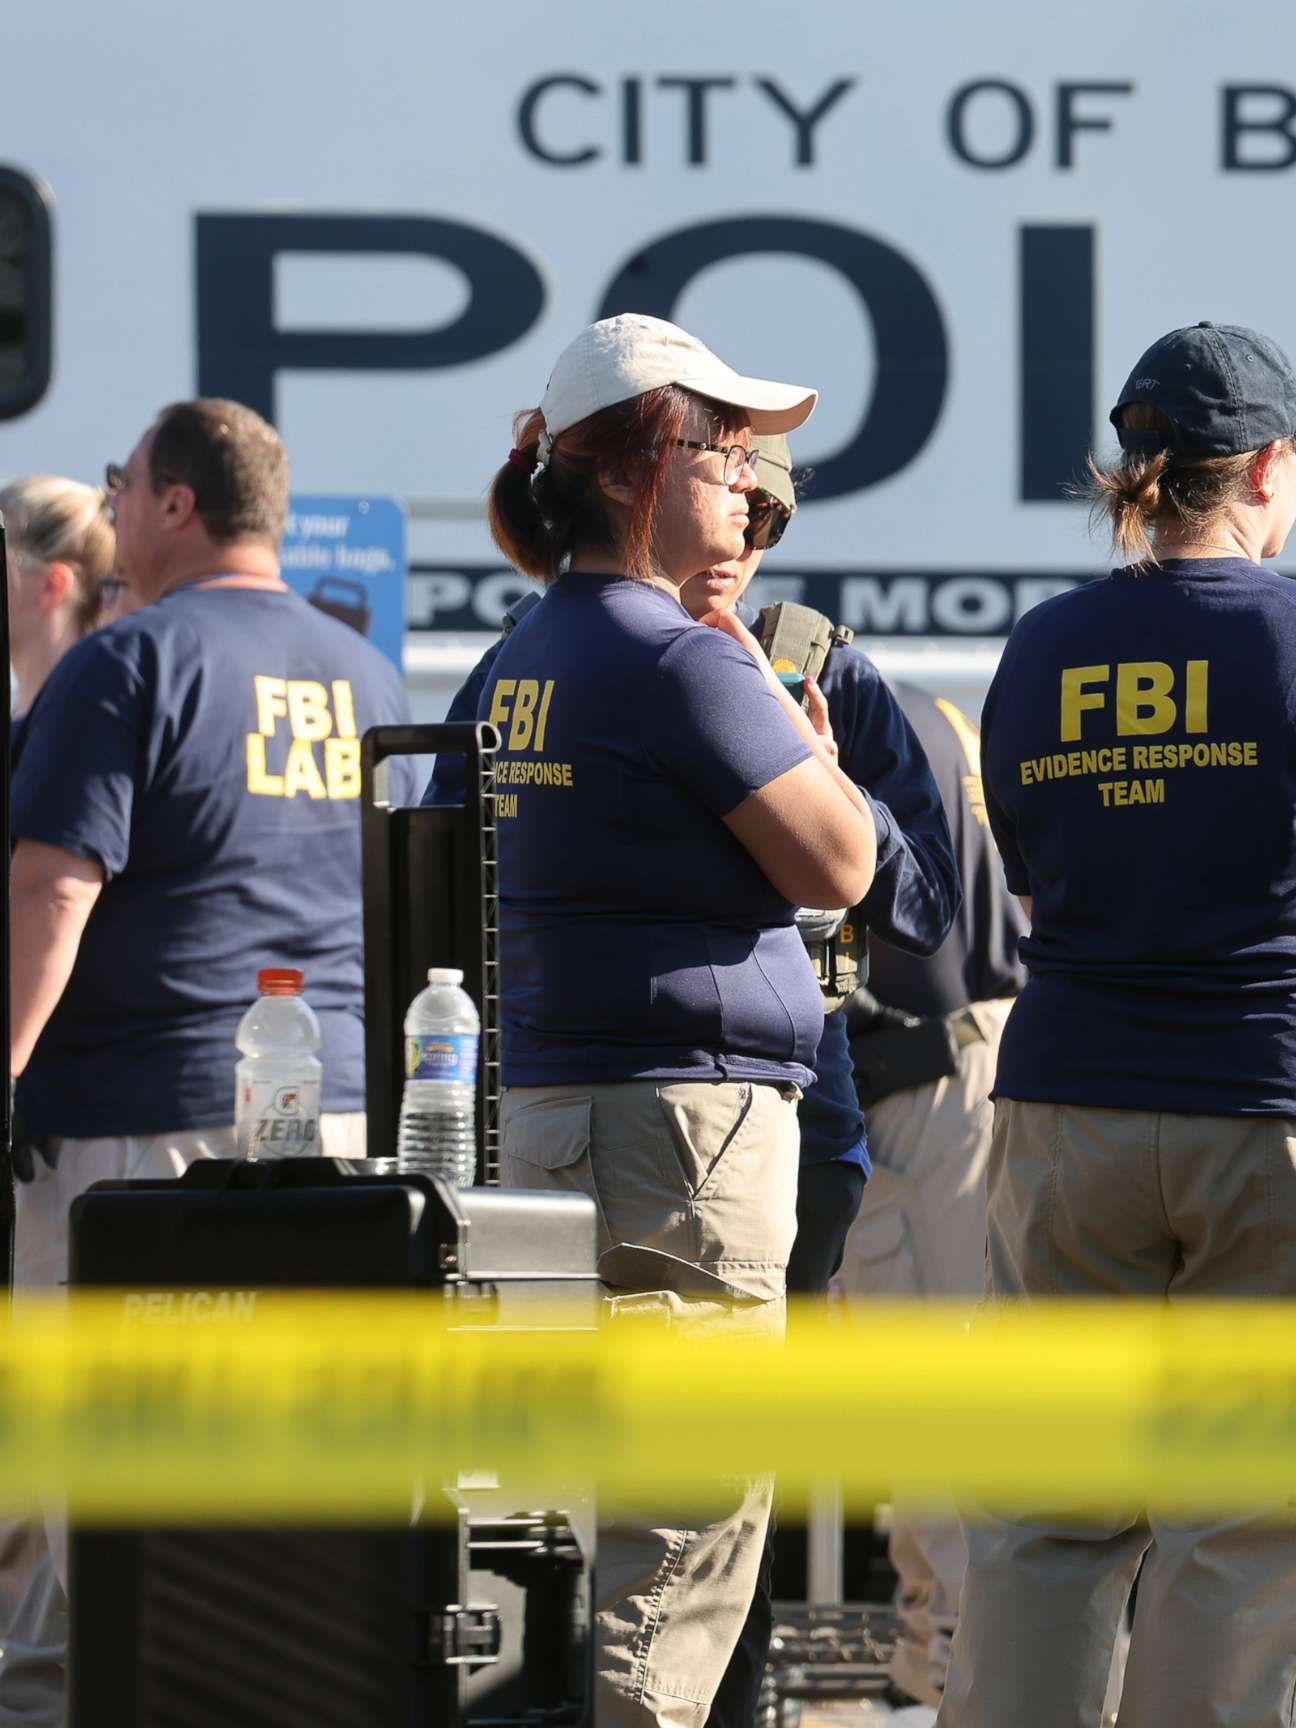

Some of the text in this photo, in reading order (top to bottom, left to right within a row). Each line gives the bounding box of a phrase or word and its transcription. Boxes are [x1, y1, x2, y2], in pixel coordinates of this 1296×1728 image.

[518, 73, 856, 168] CITY
[946, 79, 1134, 171] OF
[254, 674, 357, 741] FBI
[489, 679, 555, 752] FBI
[1060, 659, 1208, 742] FBI
[246, 732, 362, 800] LAB
[509, 761, 574, 787] RESPONSE
[1020, 742, 1259, 785] EVIDENCE RESPONSE
[494, 793, 518, 817] TEAM
[1098, 779, 1165, 807] TEAM
[255, 1118, 315, 1141] ZERO
[125, 1291, 257, 1327] PELICAN
